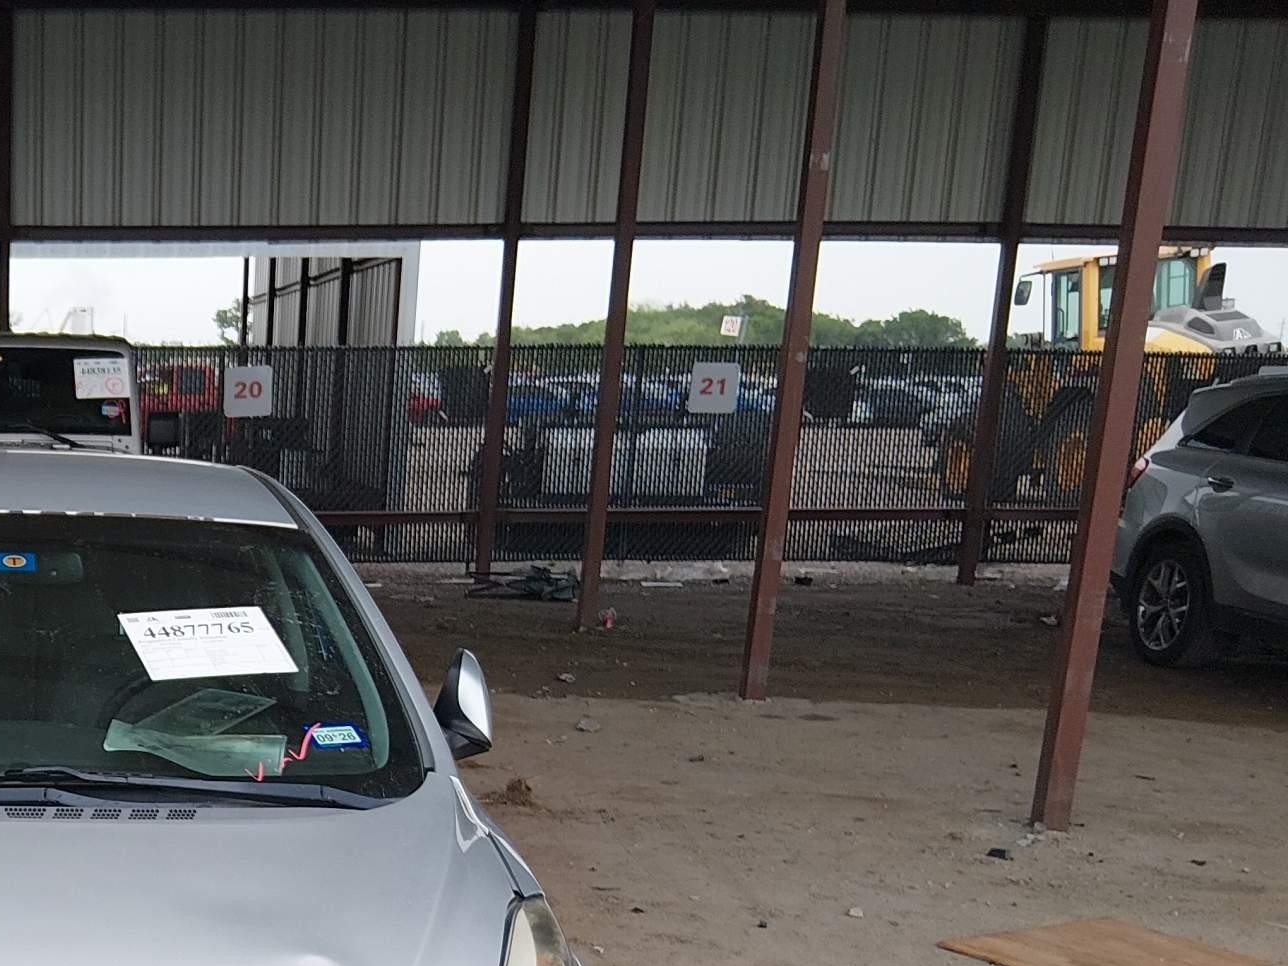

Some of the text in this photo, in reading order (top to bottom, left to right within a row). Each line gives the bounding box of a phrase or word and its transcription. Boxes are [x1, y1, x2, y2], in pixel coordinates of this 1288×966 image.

[233, 380, 263, 400] 20
[699, 377, 727, 396] 21
[143, 620, 255, 639] 44877765
[316, 731, 357, 743] 09 26
